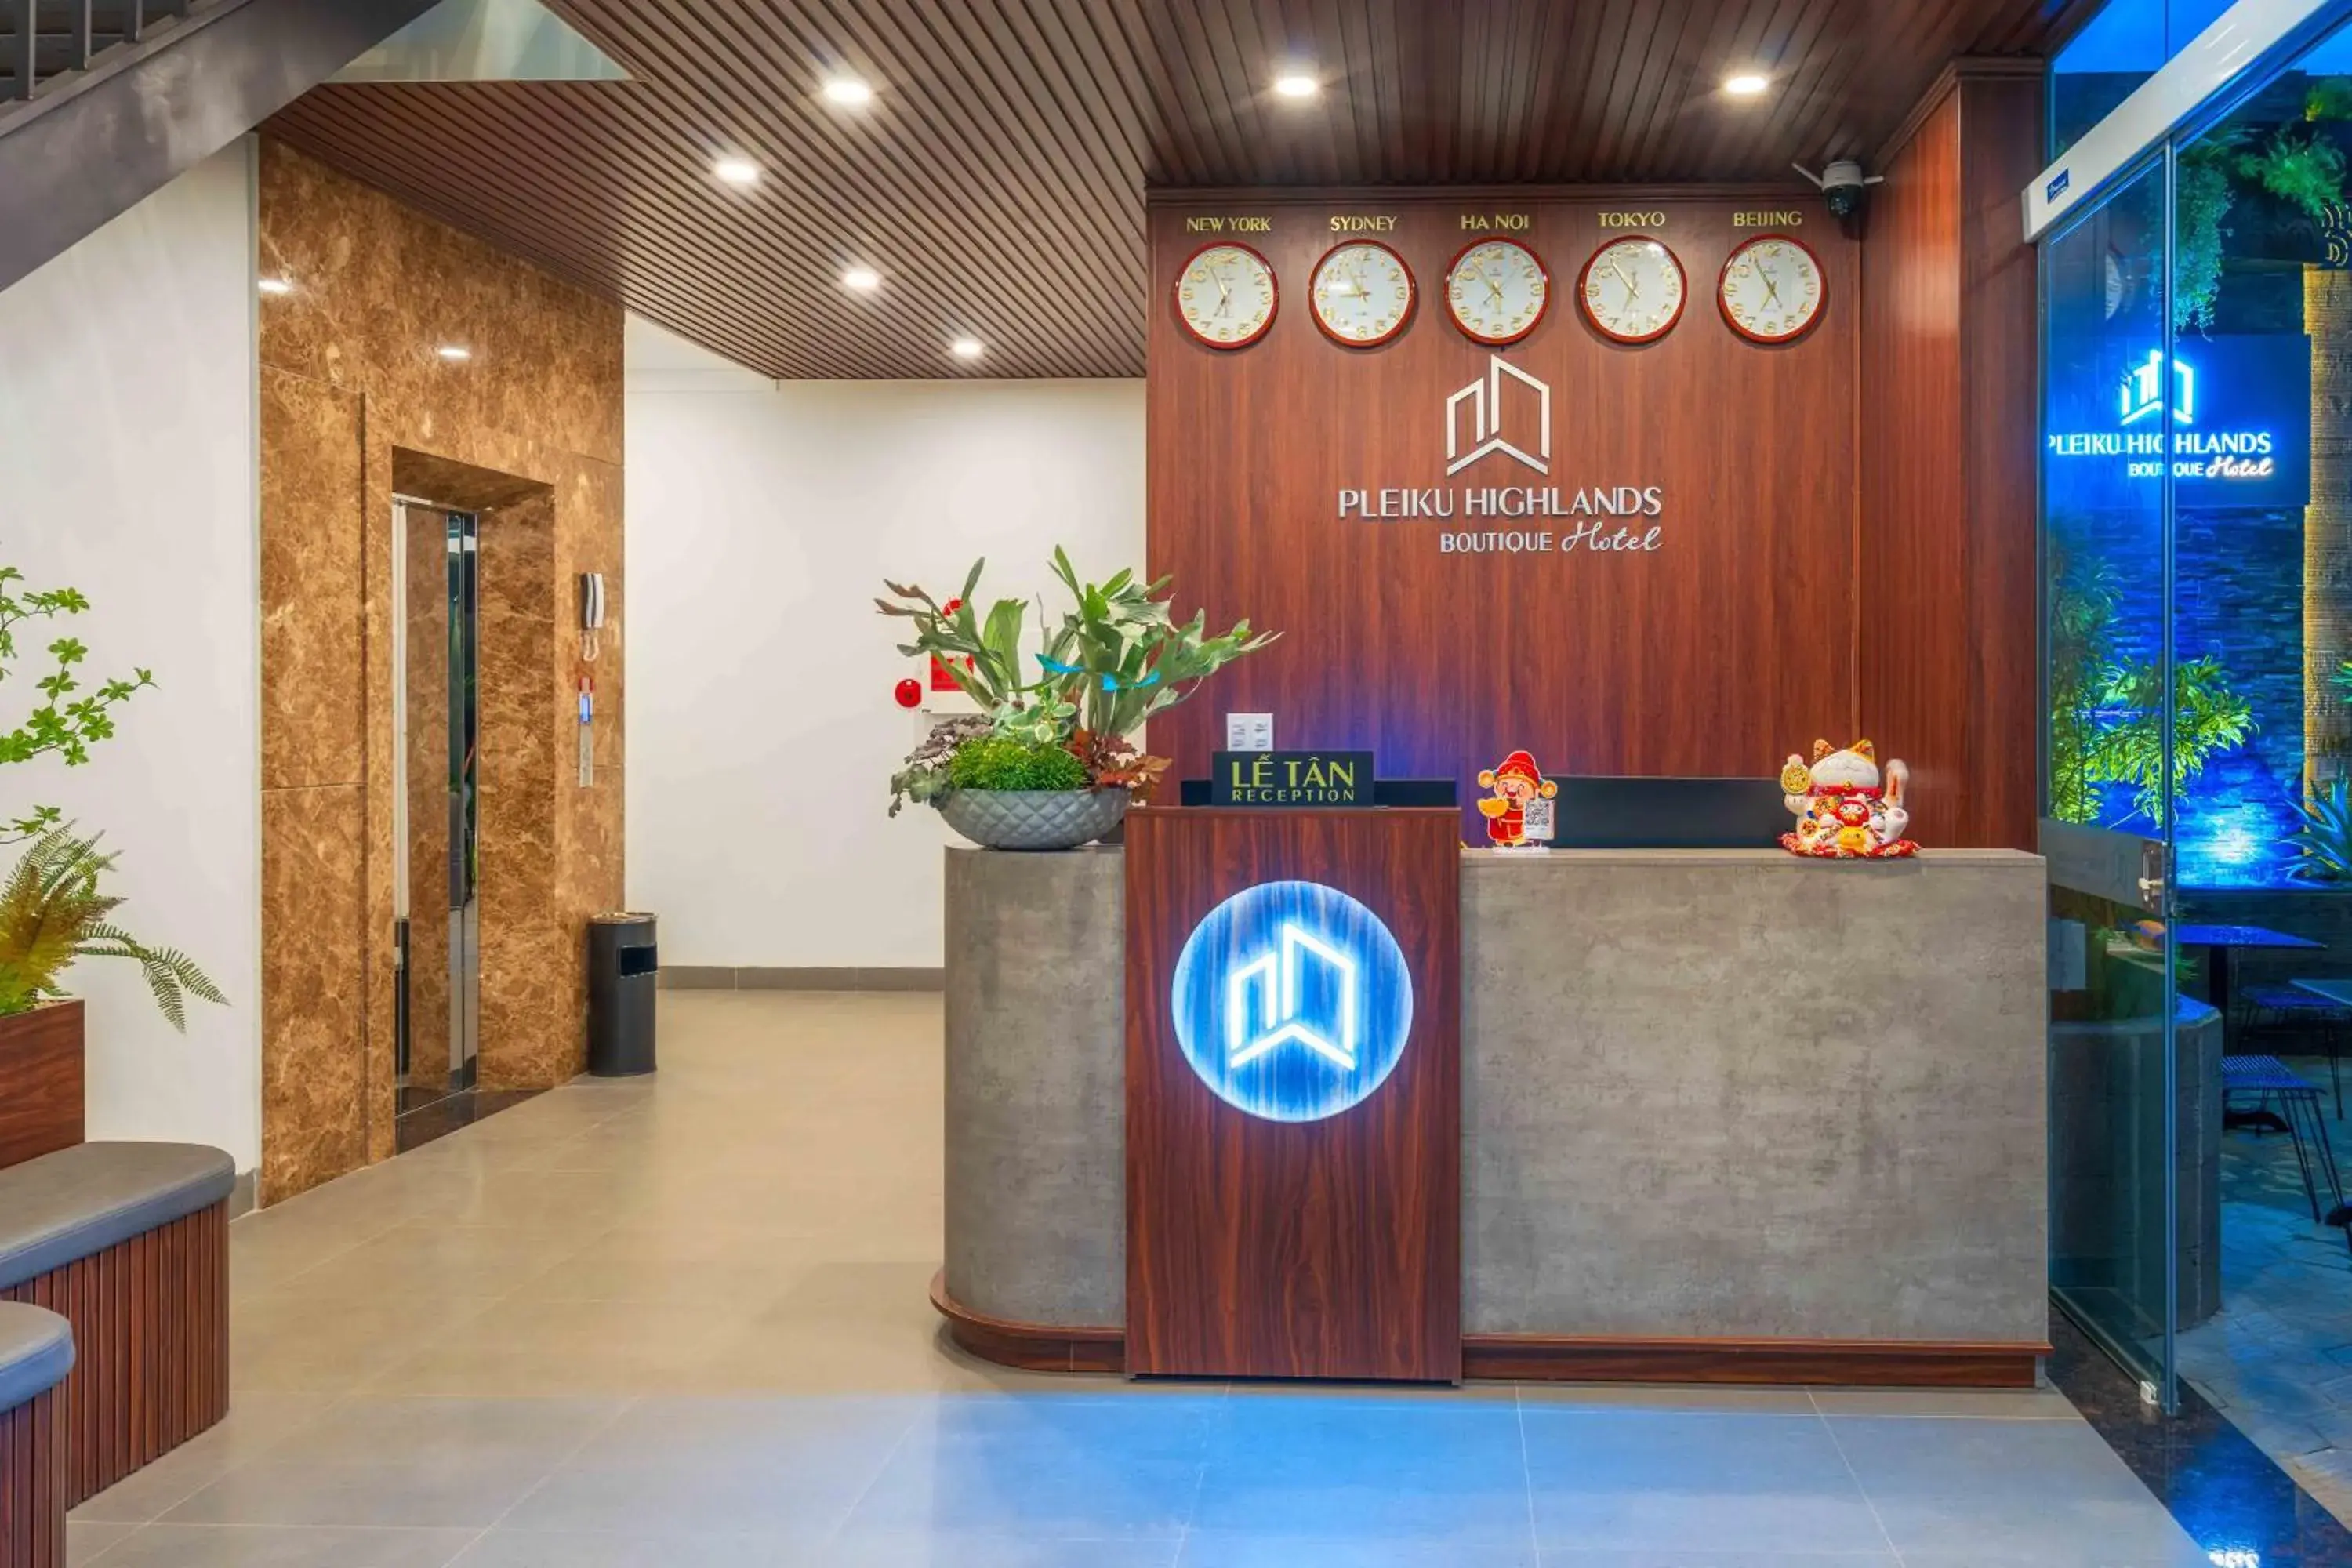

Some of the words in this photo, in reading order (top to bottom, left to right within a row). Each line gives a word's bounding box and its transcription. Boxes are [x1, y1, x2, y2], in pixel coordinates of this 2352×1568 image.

[1186, 216, 1224, 232] NEW
[1228, 216, 1272, 232] YORK
[1330, 216, 1398, 232] SYDNEY
[1461, 214, 1490, 230] HA
[1495, 214, 1529, 230] NOI
[1598, 212, 1666, 227] TOKYO
[1733, 211, 1802, 227] BEIJING
[2129, 462, 2205, 477] BOUQUE
[2205, 455, 2274, 479] Hotel
[1338, 488, 1454, 517] PLEIKU
[1465, 486, 1662, 516] HIGHLANDS
[1440, 531, 1553, 553] BOUTIQUE
[1561, 521, 1664, 552] Hotel
[1283, 757, 1355, 788] TÂN
[1232, 789, 1355, 802] RECEPTION
